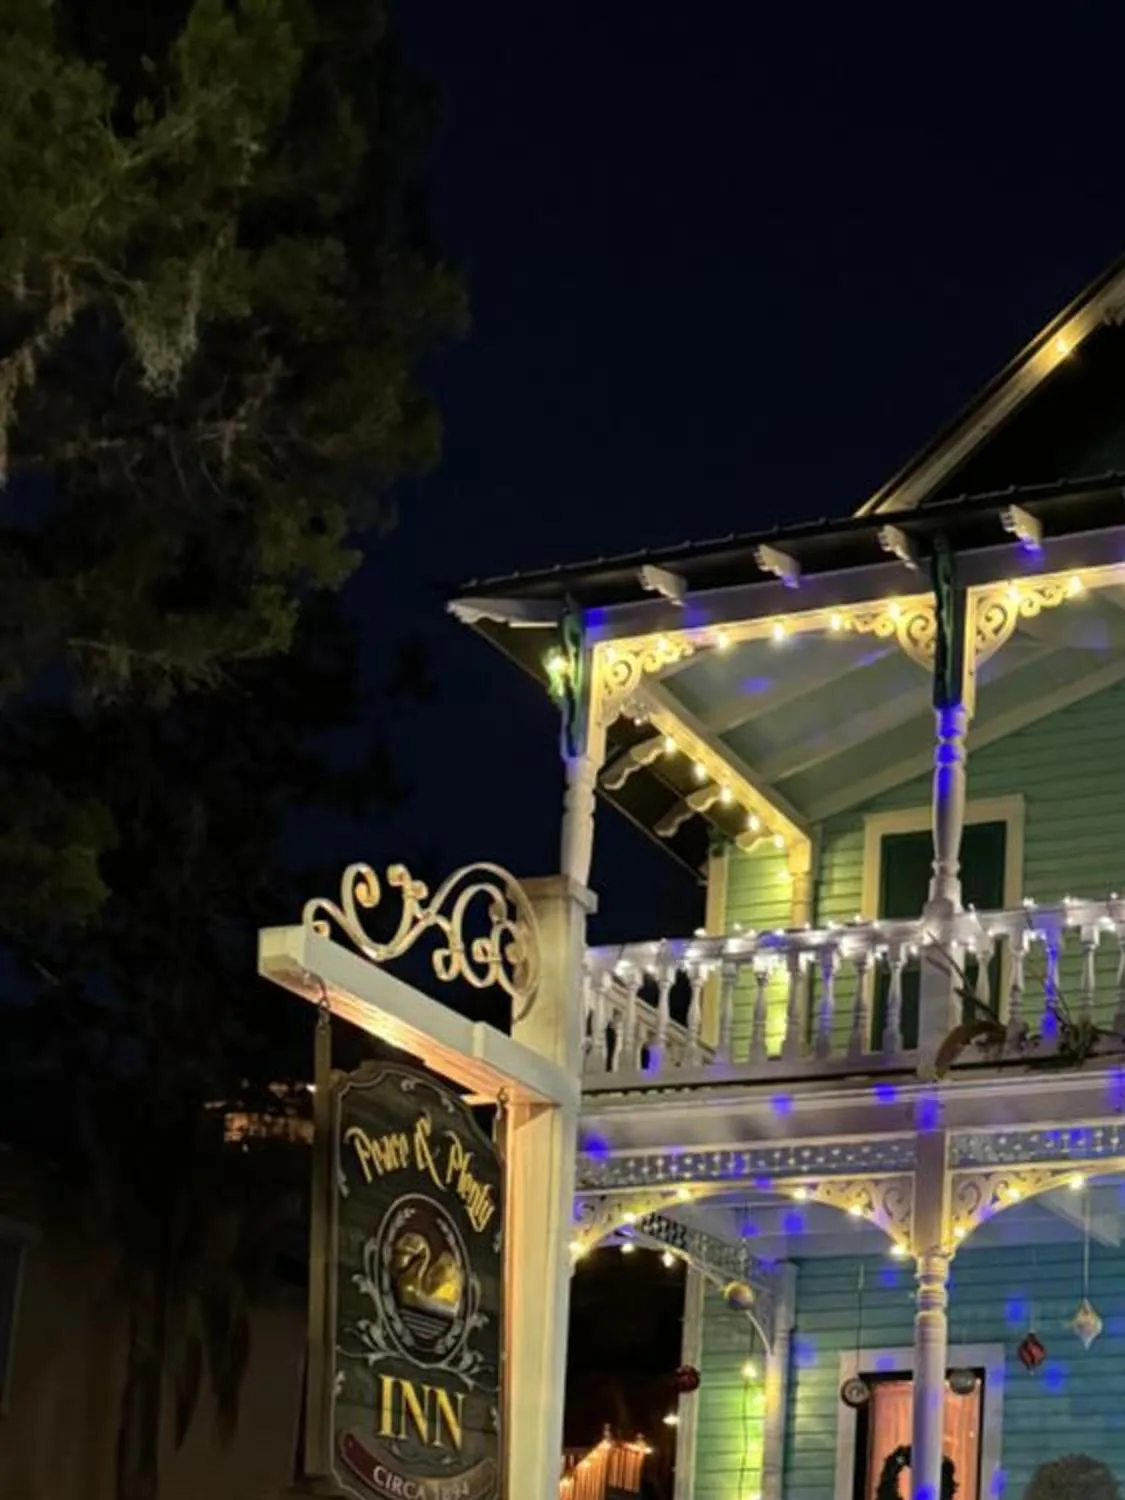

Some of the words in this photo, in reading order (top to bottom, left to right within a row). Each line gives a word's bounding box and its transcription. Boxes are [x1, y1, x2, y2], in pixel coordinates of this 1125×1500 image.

[344, 1126, 409, 1183] Peace
[446, 1130, 495, 1232] Plenty
[378, 1374, 465, 1450] INN
[373, 1465, 426, 1500] CIRCA
